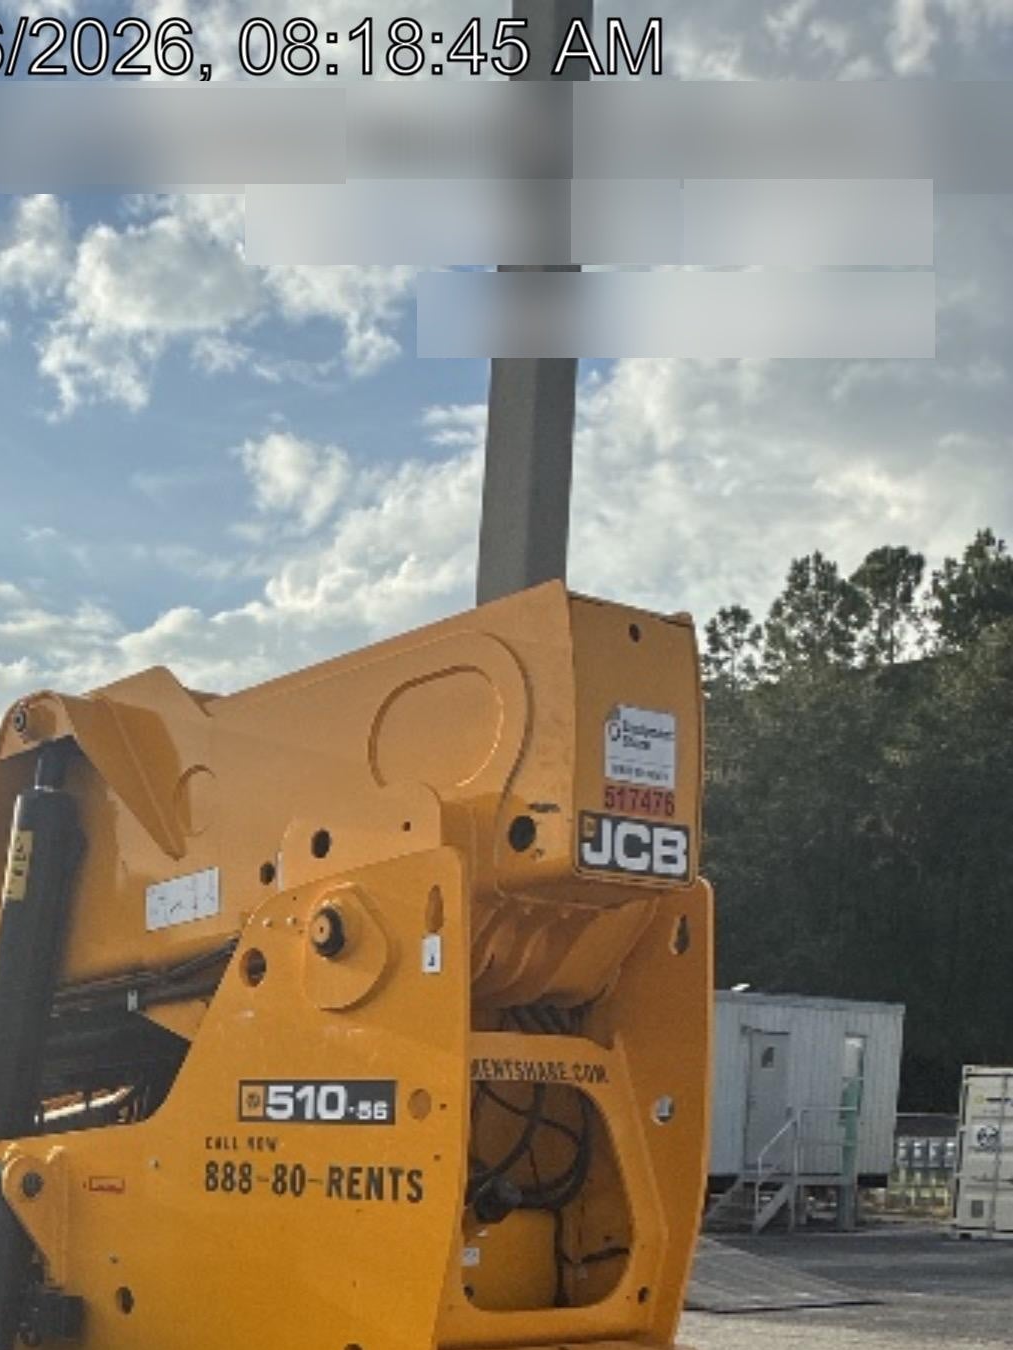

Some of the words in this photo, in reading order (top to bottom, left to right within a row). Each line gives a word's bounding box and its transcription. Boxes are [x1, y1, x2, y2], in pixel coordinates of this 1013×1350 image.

[603, 785, 676, 817] 517476
[582, 818, 688, 875] JCB
[205, 1160, 424, 1204] 888-80-RENTS
